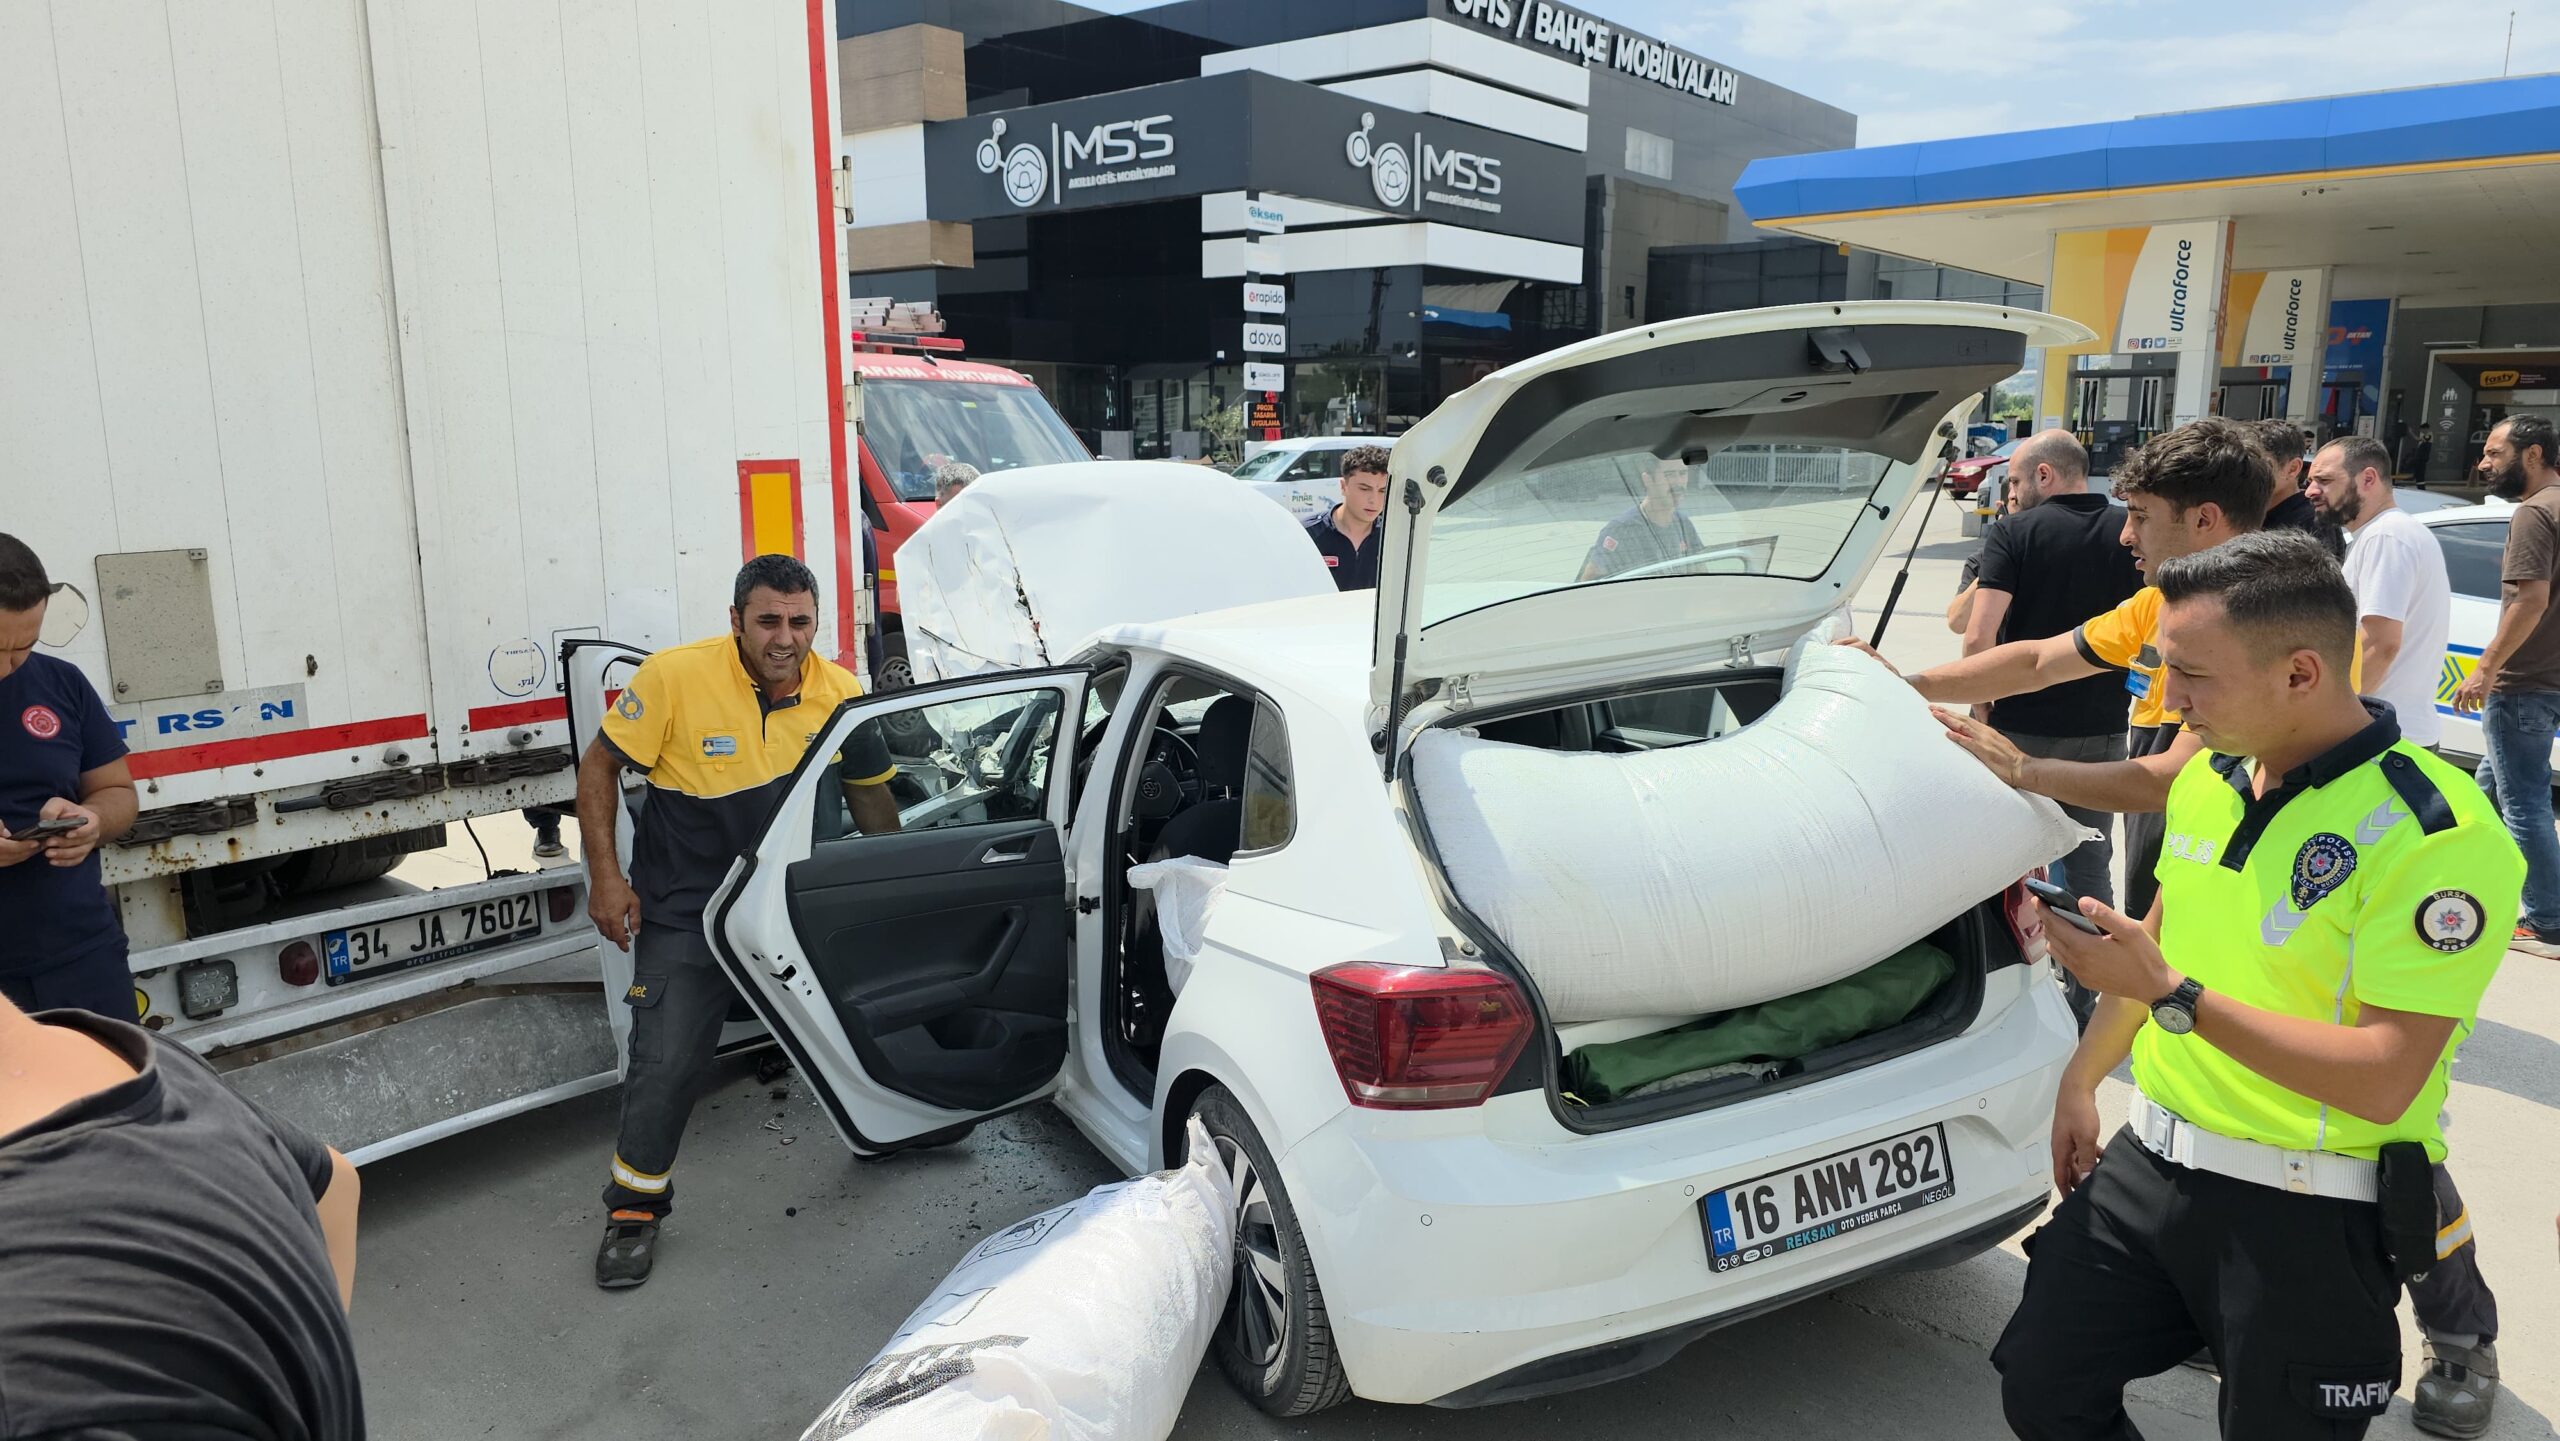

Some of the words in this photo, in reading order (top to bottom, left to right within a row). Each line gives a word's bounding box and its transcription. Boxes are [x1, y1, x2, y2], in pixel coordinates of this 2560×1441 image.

[1534, 9, 1610, 67] BAHÇE
[1615, 34, 1738, 105] MOBİLYALARI
[1249, 206, 1284, 222] eksen
[2169, 239, 2192, 332] ultraforce
[2283, 278, 2302, 351] ultraforce
[1249, 330, 1282, 346] doxa
[859, 365, 929, 378] ARAMA
[2318, 836, 2352, 857] POLİS
[2433, 890, 2467, 900] BURSA
[350, 927, 388, 966] 34
[410, 915, 446, 952] JA
[461, 894, 533, 940] 7602
[332, 955, 349, 967] TR
[1735, 1185, 1780, 1240] 16
[1794, 1157, 1867, 1224] ANM
[1869, 1135, 1940, 1198] 282
[1714, 1227, 1733, 1244] TR
[1786, 1223, 1836, 1250] REKSAN
[1840, 1217, 1855, 1231] OTO
[1856, 1208, 1879, 1225] YEDEK
[1880, 1202, 1902, 1217] PARÇA
